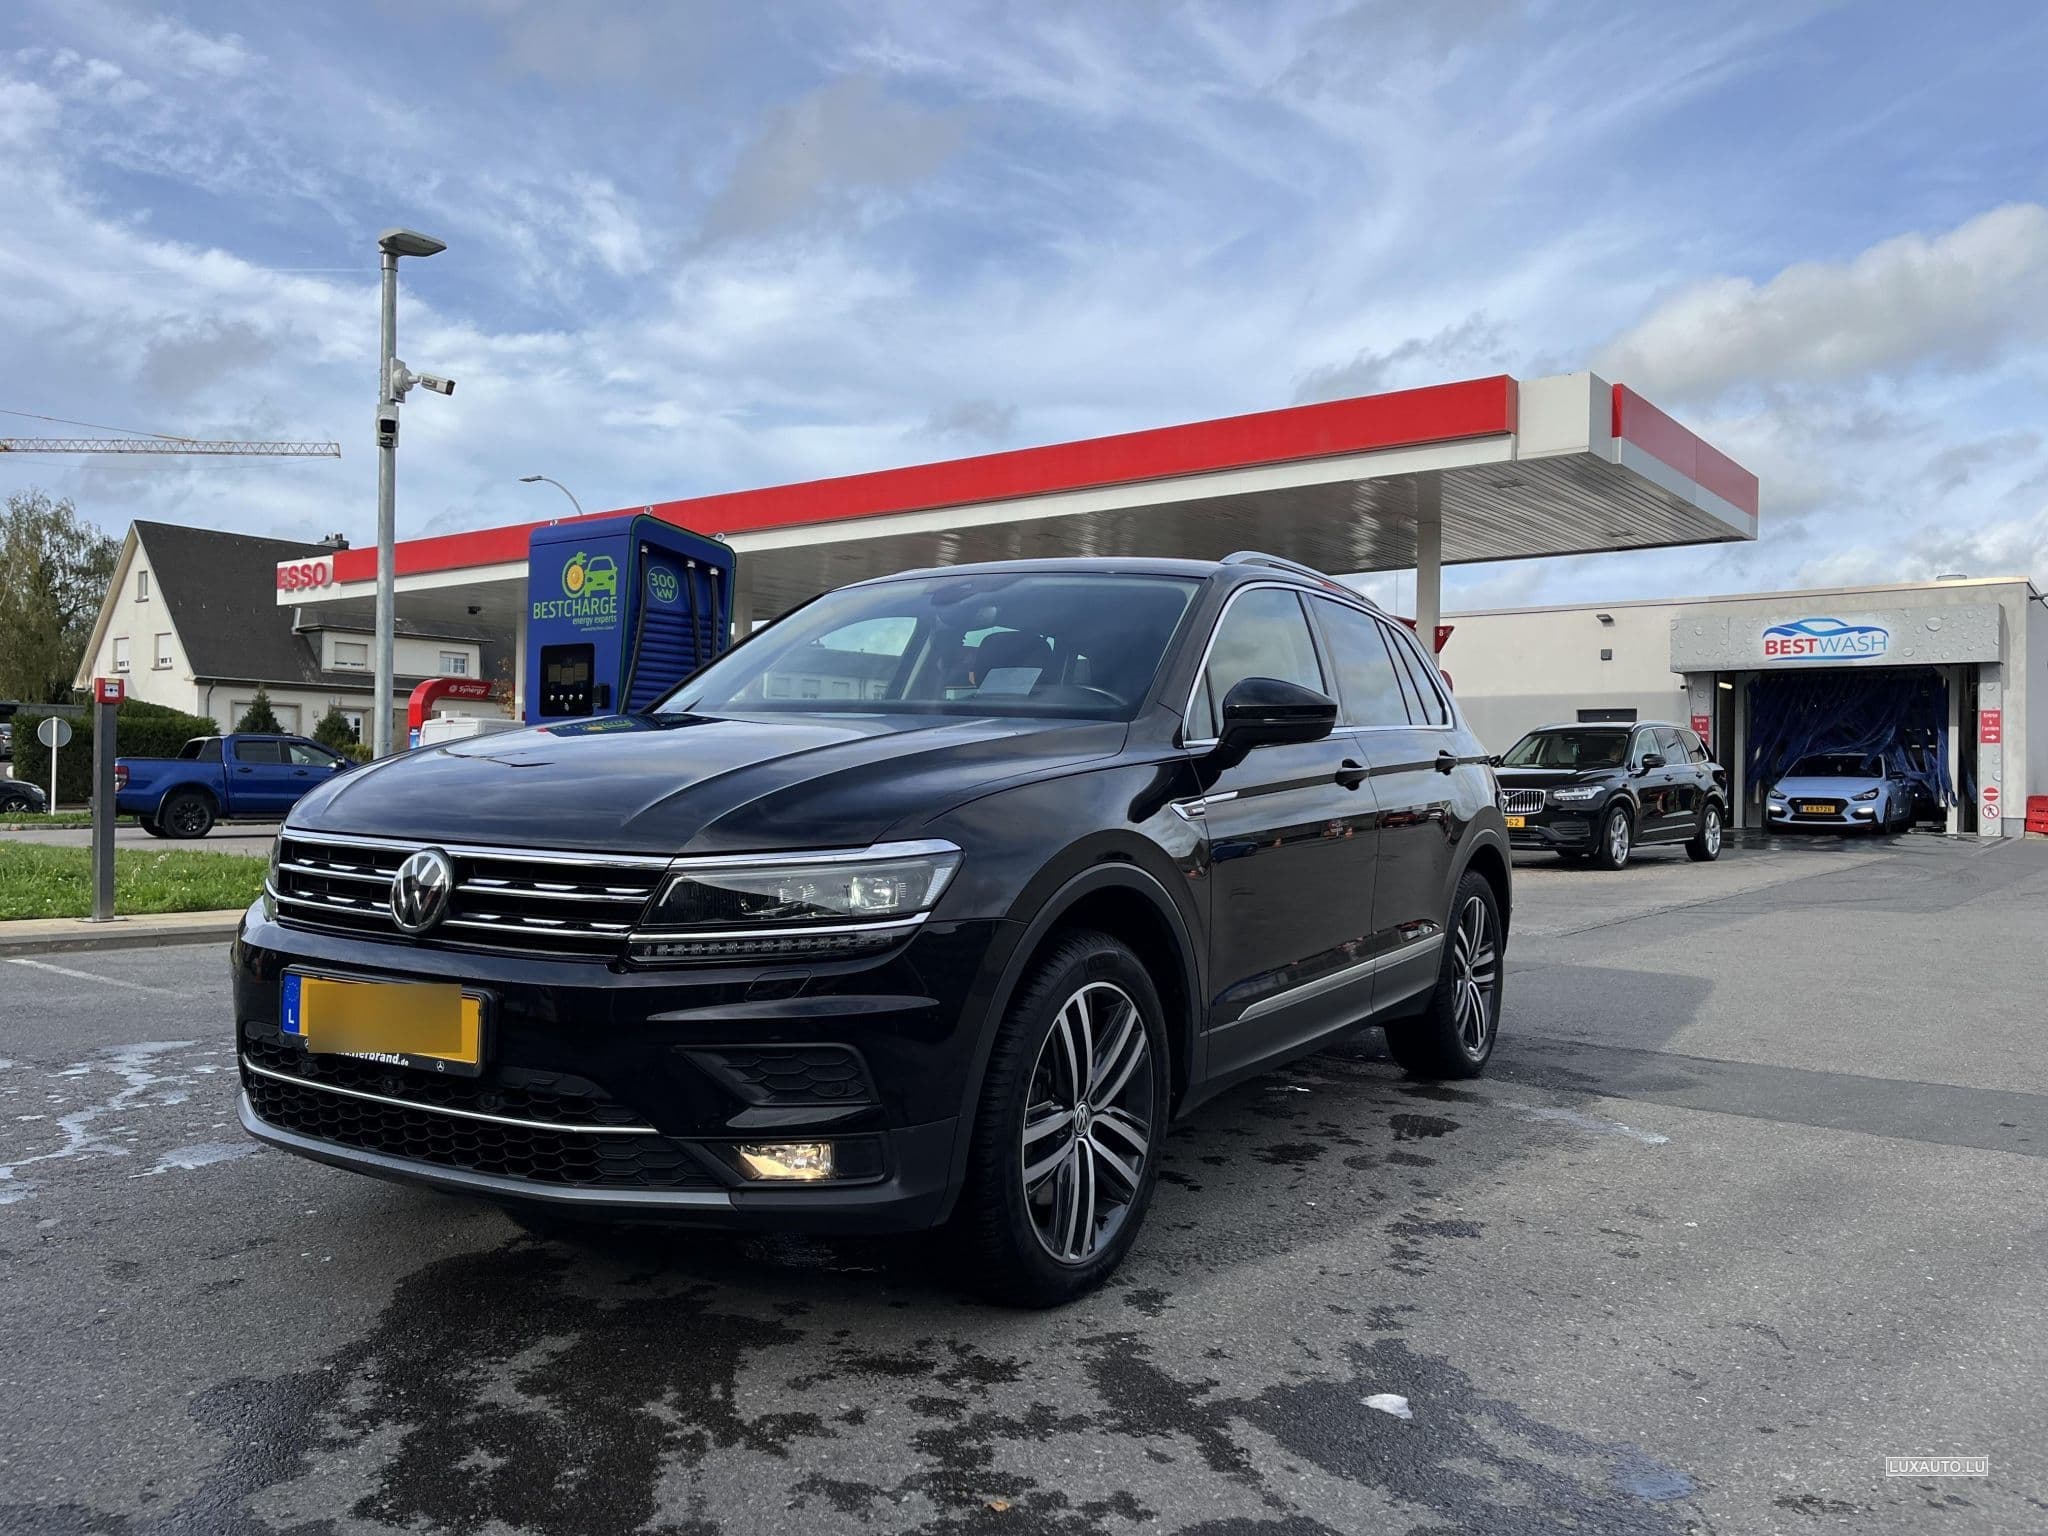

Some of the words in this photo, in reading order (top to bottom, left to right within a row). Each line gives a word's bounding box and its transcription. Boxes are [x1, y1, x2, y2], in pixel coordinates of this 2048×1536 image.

[276, 562, 327, 589] ESSO
[651, 572, 675, 589] 300
[657, 588, 673, 599] kW
[533, 597, 617, 619] BESTCHARGE
[572, 616, 593, 626] energy
[594, 615, 617, 624] experts
[1765, 636, 1886, 655] BESTWASH
[288, 1008, 295, 1024] L
